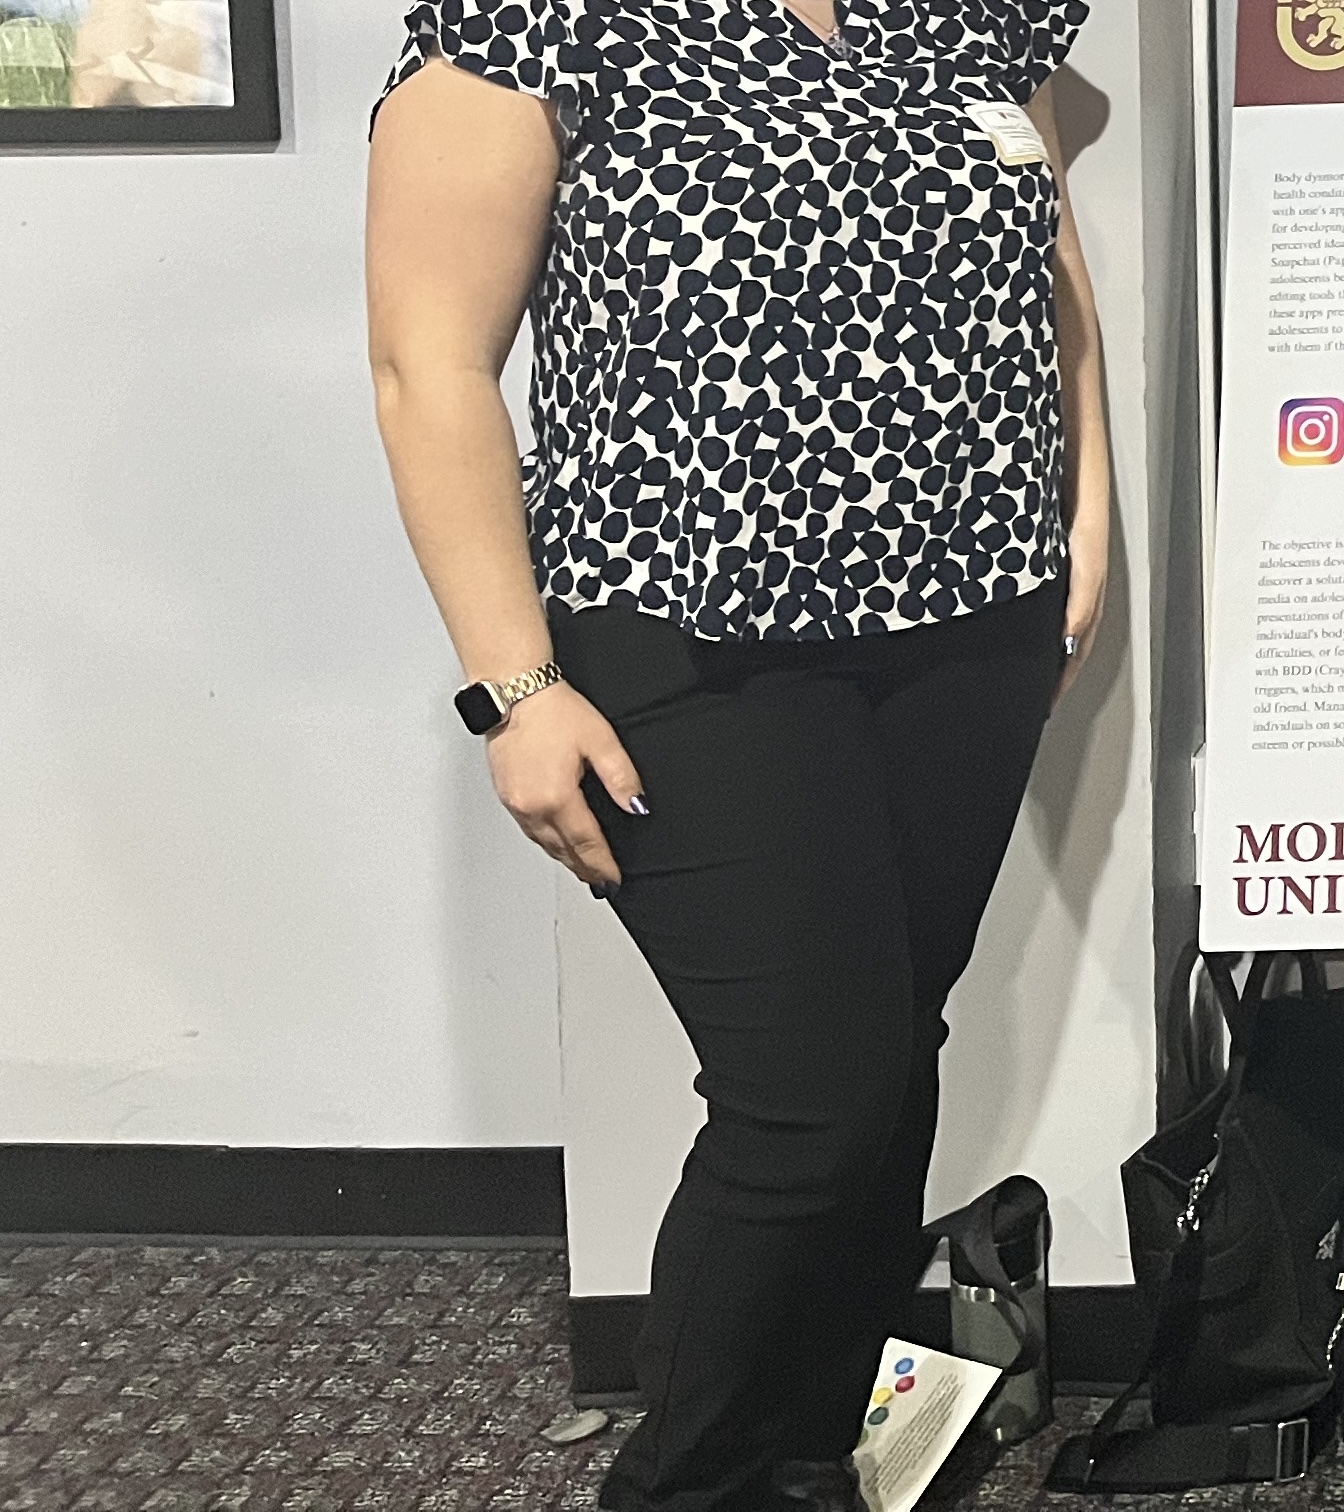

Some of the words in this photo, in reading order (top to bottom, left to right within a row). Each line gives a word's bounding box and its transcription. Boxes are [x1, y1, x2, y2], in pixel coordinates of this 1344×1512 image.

[1257, 539, 1281, 551] The
[1282, 538, 1332, 553] objective
[1334, 538, 1344, 549] is
